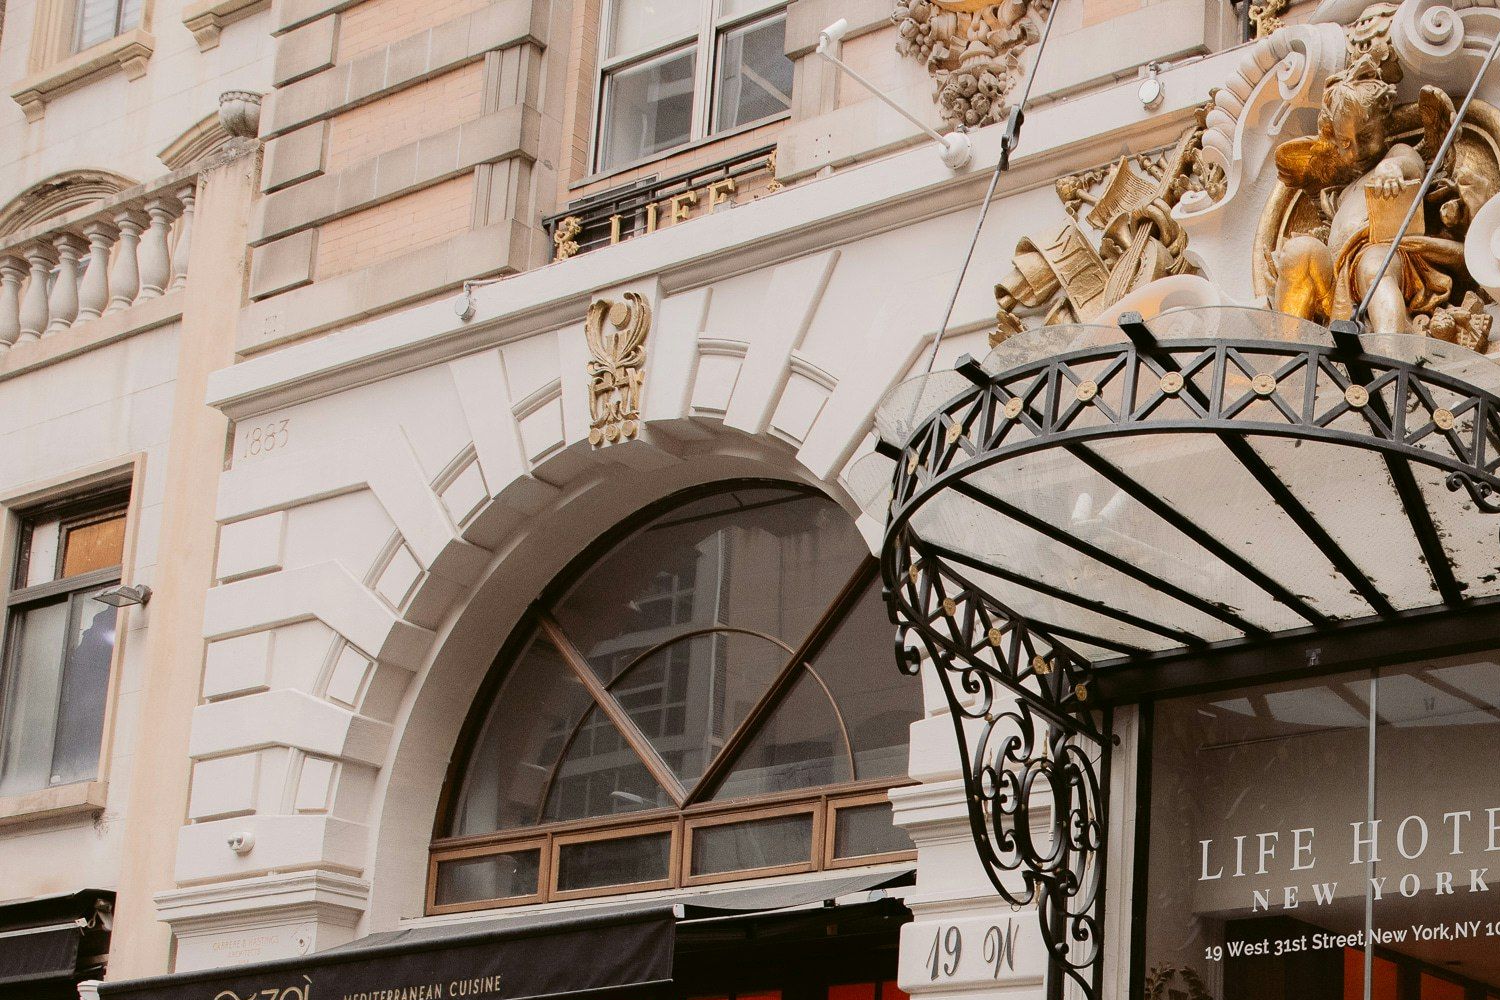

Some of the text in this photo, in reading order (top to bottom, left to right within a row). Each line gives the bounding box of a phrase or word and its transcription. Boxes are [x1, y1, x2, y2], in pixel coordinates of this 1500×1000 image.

[243, 418, 291, 459] 1883
[1198, 827, 1317, 881] LIFE
[1252, 868, 1490, 912] NEW YORK
[926, 917, 1020, 981] 19 W
[1204, 945, 1223, 962] 19
[1227, 938, 1270, 959] West
[1274, 934, 1307, 955] 31st
[450, 975, 501, 997] CUISINE
